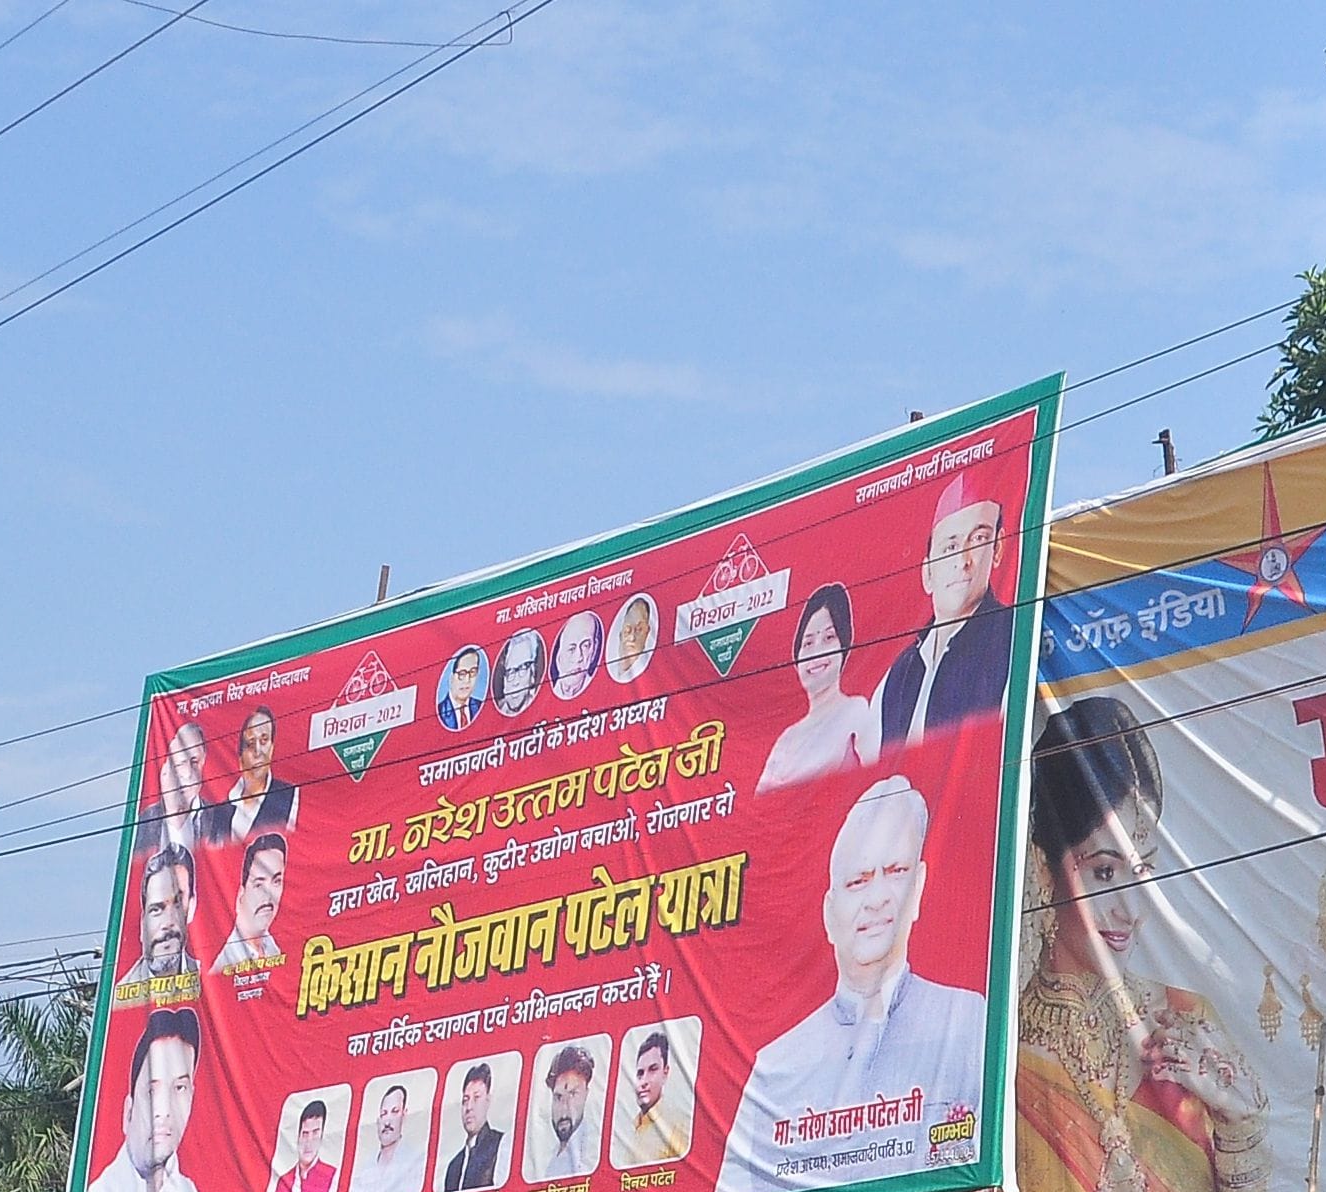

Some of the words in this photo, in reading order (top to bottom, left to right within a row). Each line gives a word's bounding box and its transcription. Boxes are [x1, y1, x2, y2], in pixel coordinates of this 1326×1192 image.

[855, 464, 912, 503] समाजवादी
[913, 451, 939, 481] पार्टी
[513, 591, 558, 619] अखिलेश
[559, 582, 586, 606] यादव
[1137, 586, 1226, 643] इंडिया
[418, 736, 505, 787] समाजवादी
[509, 720, 547, 761] पार्टी
[566, 710, 606, 747] प्रदेश
[608, 696, 668, 733] अध्यक्ष
[346, 824, 396, 866] मा.
[401, 796, 487, 854] नरेश
[491, 767, 591, 827] उत्तम
[594, 741, 672, 801] पटेल
[674, 718, 727, 779] जी
[327, 883, 364, 919] द्वारा
[366, 872, 401, 905] खेत,
[404, 856, 478, 894] खलिहान,
[482, 840, 527, 883] कुटीर
[529, 828, 579, 864] उद्योग
[580, 806, 641, 851] बचाओ,
[646, 799, 712, 837] रोजगार
[715, 780, 737, 816] दो
[295, 932, 415, 1022] किसान
[415, 899, 564, 993] नौजवान
[563, 866, 656, 962] पटेल
[656, 852, 748, 938] यात्रा
[345, 1032, 370, 1058] का
[370, 1012, 422, 1054] हार्दिक
[423, 1004, 480, 1045] स्वागत
[482, 997, 511, 1034] एवं
[510, 984, 600, 1024] अभिनन्दन
[600, 965, 645, 1006] करते
[774, 1119, 794, 1146] मा.
[797, 1107, 828, 1142] नरेश
[827, 1104, 866, 1137] उत्तम
[866, 1093, 902, 1130] पटेल
[902, 1087, 924, 1123] जी
[621, 1171, 651, 1192] विनय
[650, 1166, 676, 1187] पटेल
